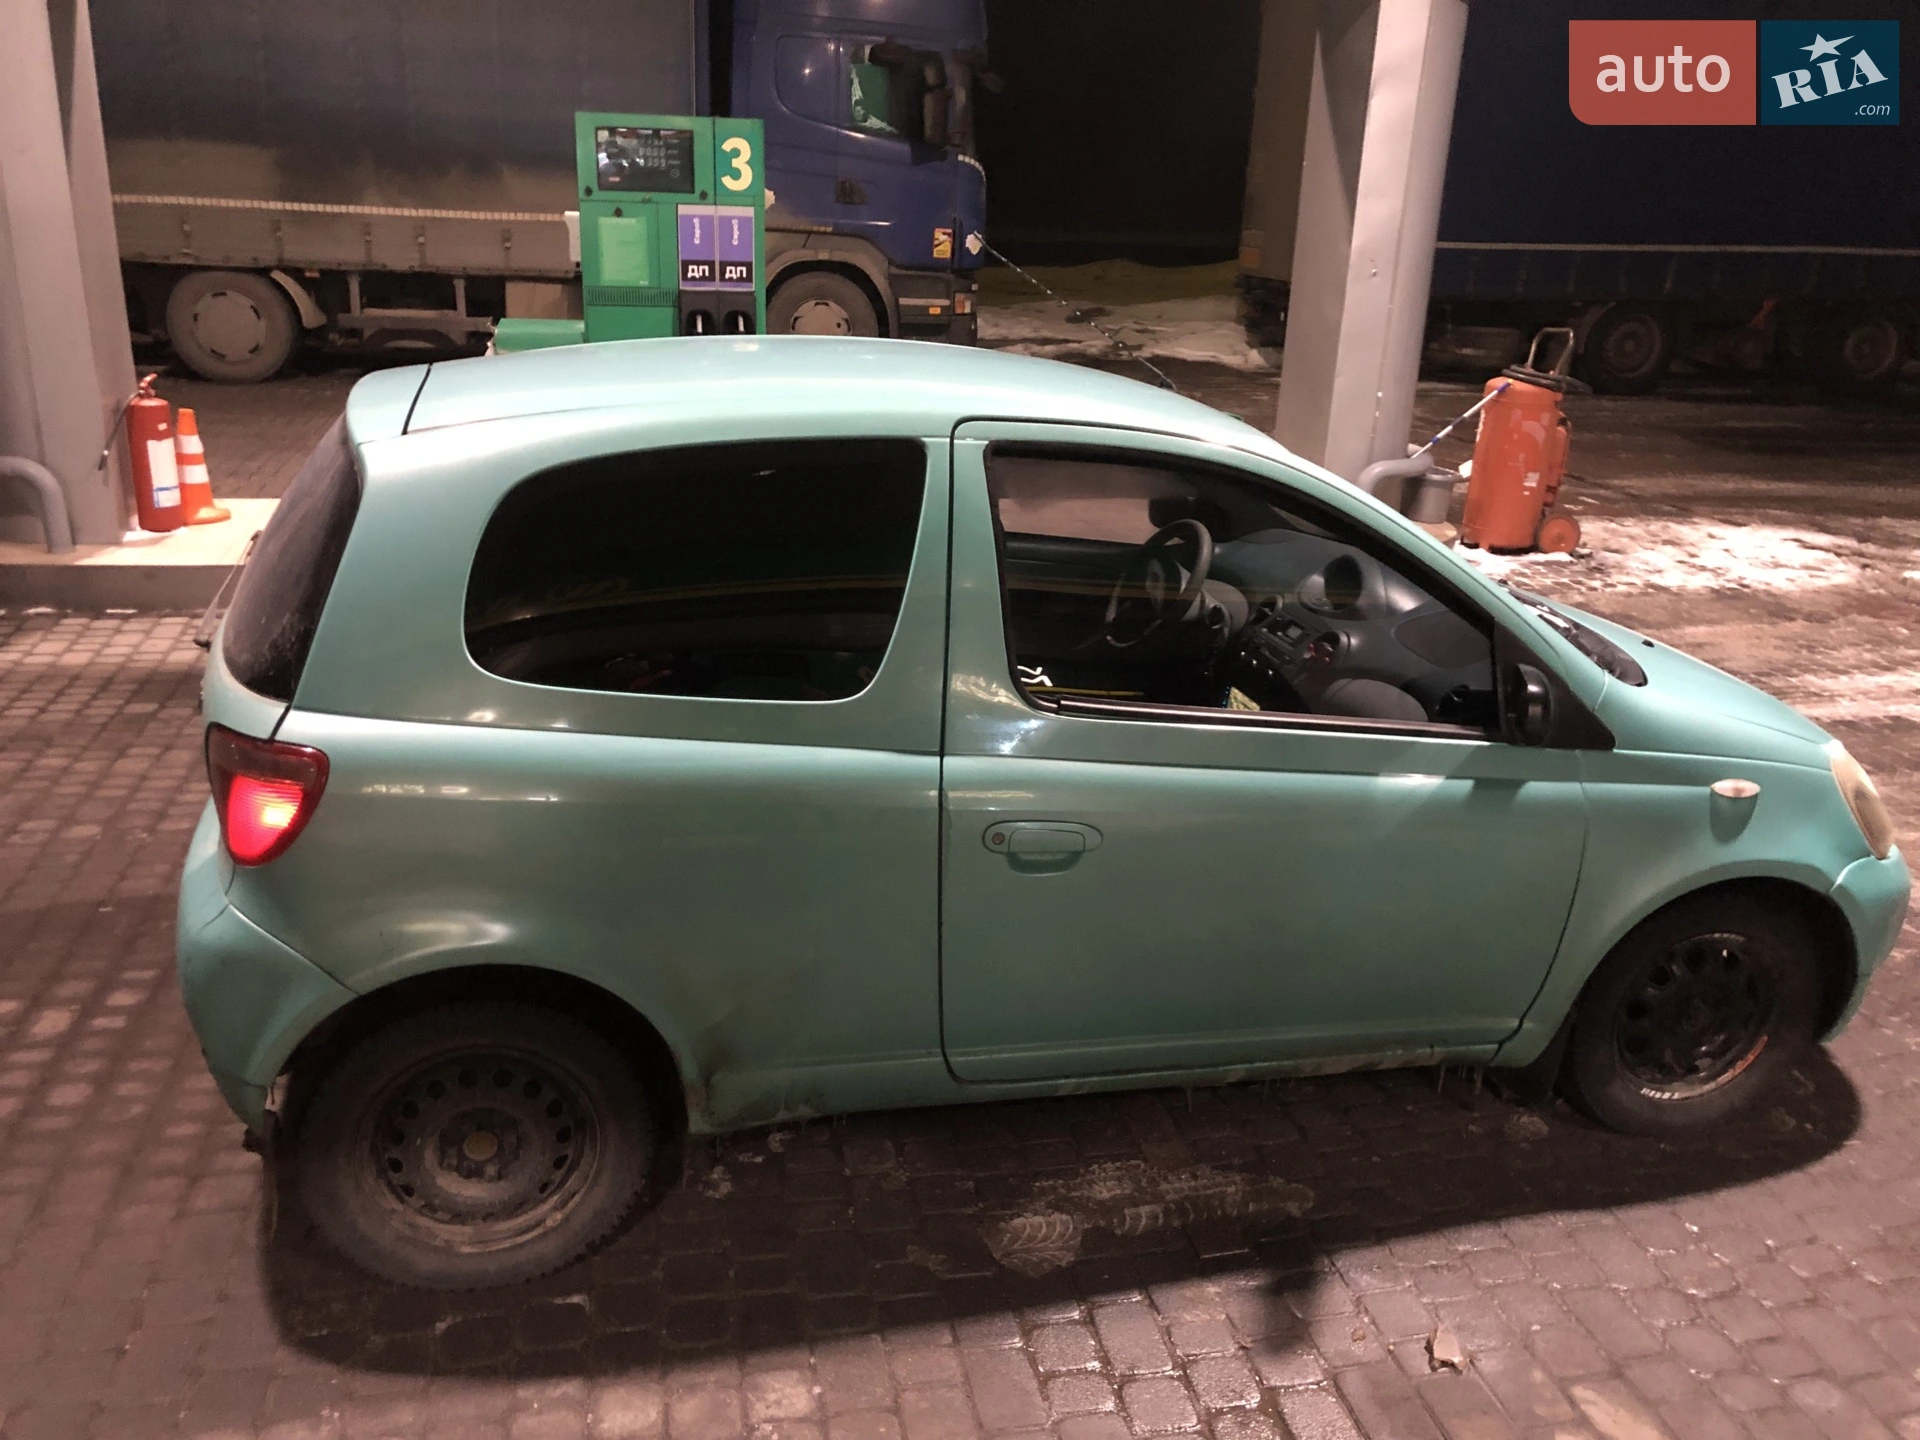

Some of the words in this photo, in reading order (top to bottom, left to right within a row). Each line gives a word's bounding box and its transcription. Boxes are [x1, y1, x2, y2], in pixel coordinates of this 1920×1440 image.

[721, 136, 753, 191] 3
[687, 264, 709, 278] ДП
[725, 266, 747, 279] ДП
